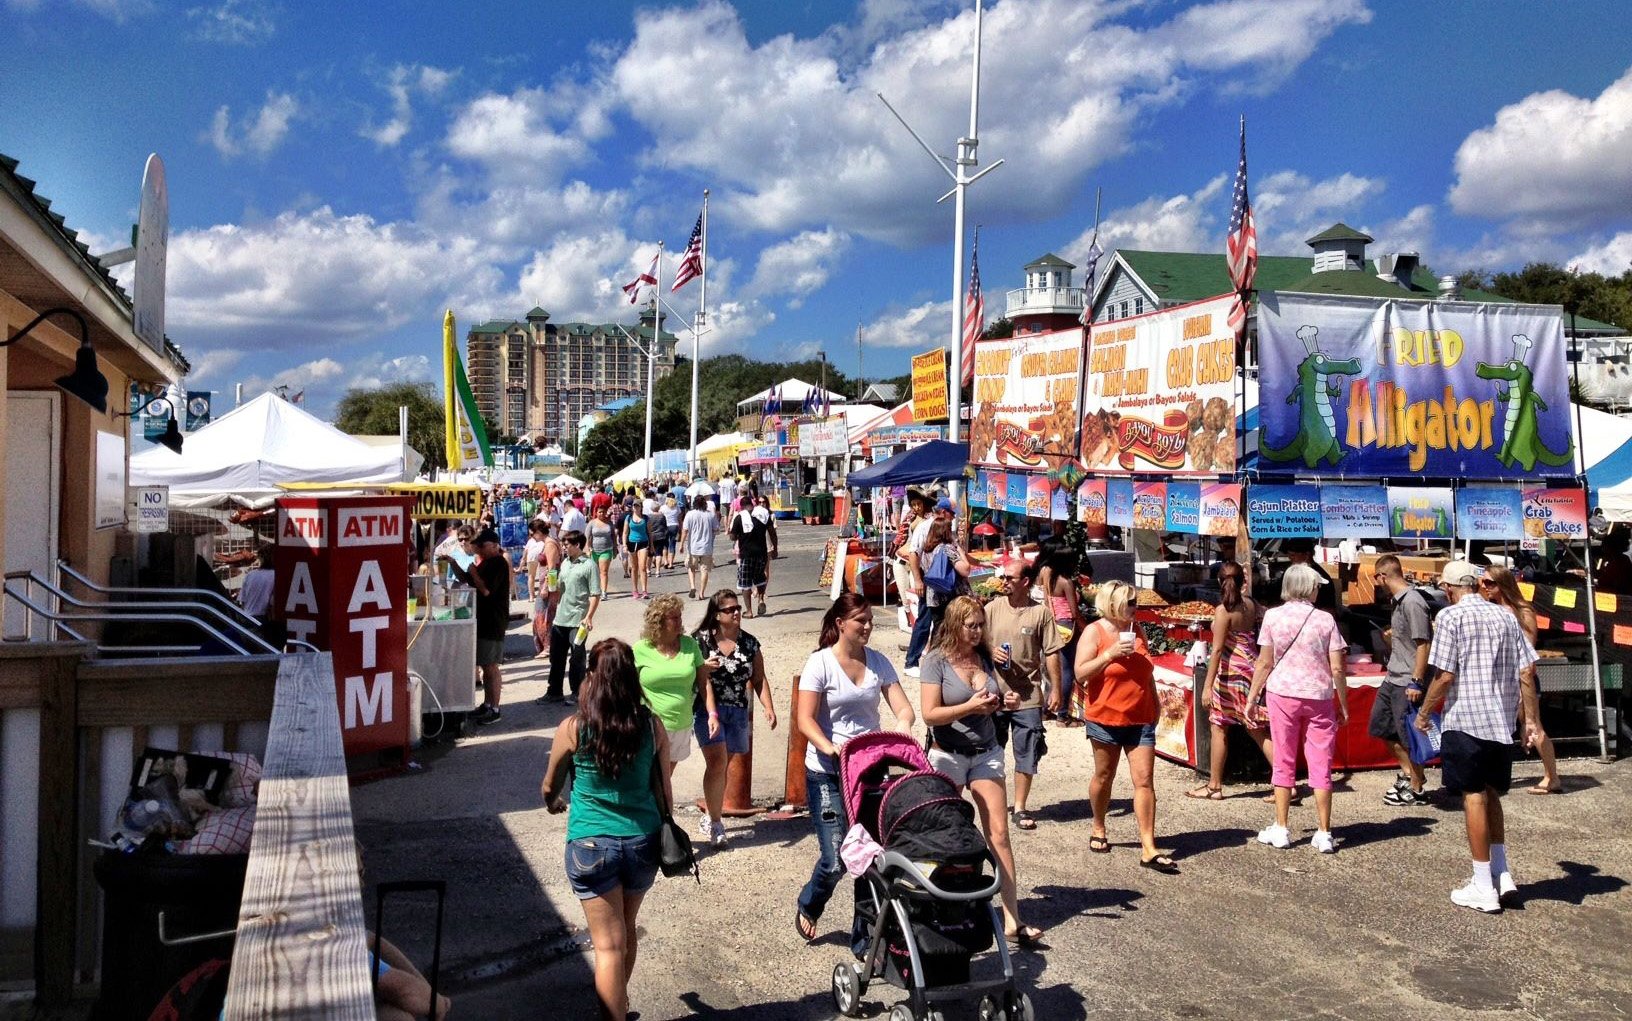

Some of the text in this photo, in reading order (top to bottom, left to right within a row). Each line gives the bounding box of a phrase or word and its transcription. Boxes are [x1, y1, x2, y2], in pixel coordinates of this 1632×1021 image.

[1372, 320, 1464, 369] FRIED
[1167, 338, 1234, 390] CRAB CAKES
[1118, 397, 1151, 411] Jambalaya
[1156, 393, 1177, 406] Bayou
[1177, 391, 1197, 402] Salads
[929, 403, 945, 417] DOGS
[1346, 377, 1495, 472] Alligator
[145, 492, 162, 504] NO
[391, 491, 476, 515] MONADE
[1203, 502, 1238, 518] Jambalaya
[1250, 500, 1319, 514] Cajun Platter
[1354, 502, 1386, 514] Platter
[1467, 505, 1512, 518] Pineapple
[1525, 505, 1552, 517] Crab
[1171, 510, 1199, 525] Salmon
[1252, 516, 1275, 524] Served
[283, 517, 324, 539] ATM
[344, 514, 399, 538] ATM
[1252, 525, 1269, 533] Corn
[1277, 525, 1292, 533] Rice
[1303, 525, 1320, 533] Salad
[1545, 520, 1582, 533] Cakes
[345, 560, 394, 729] ATM
